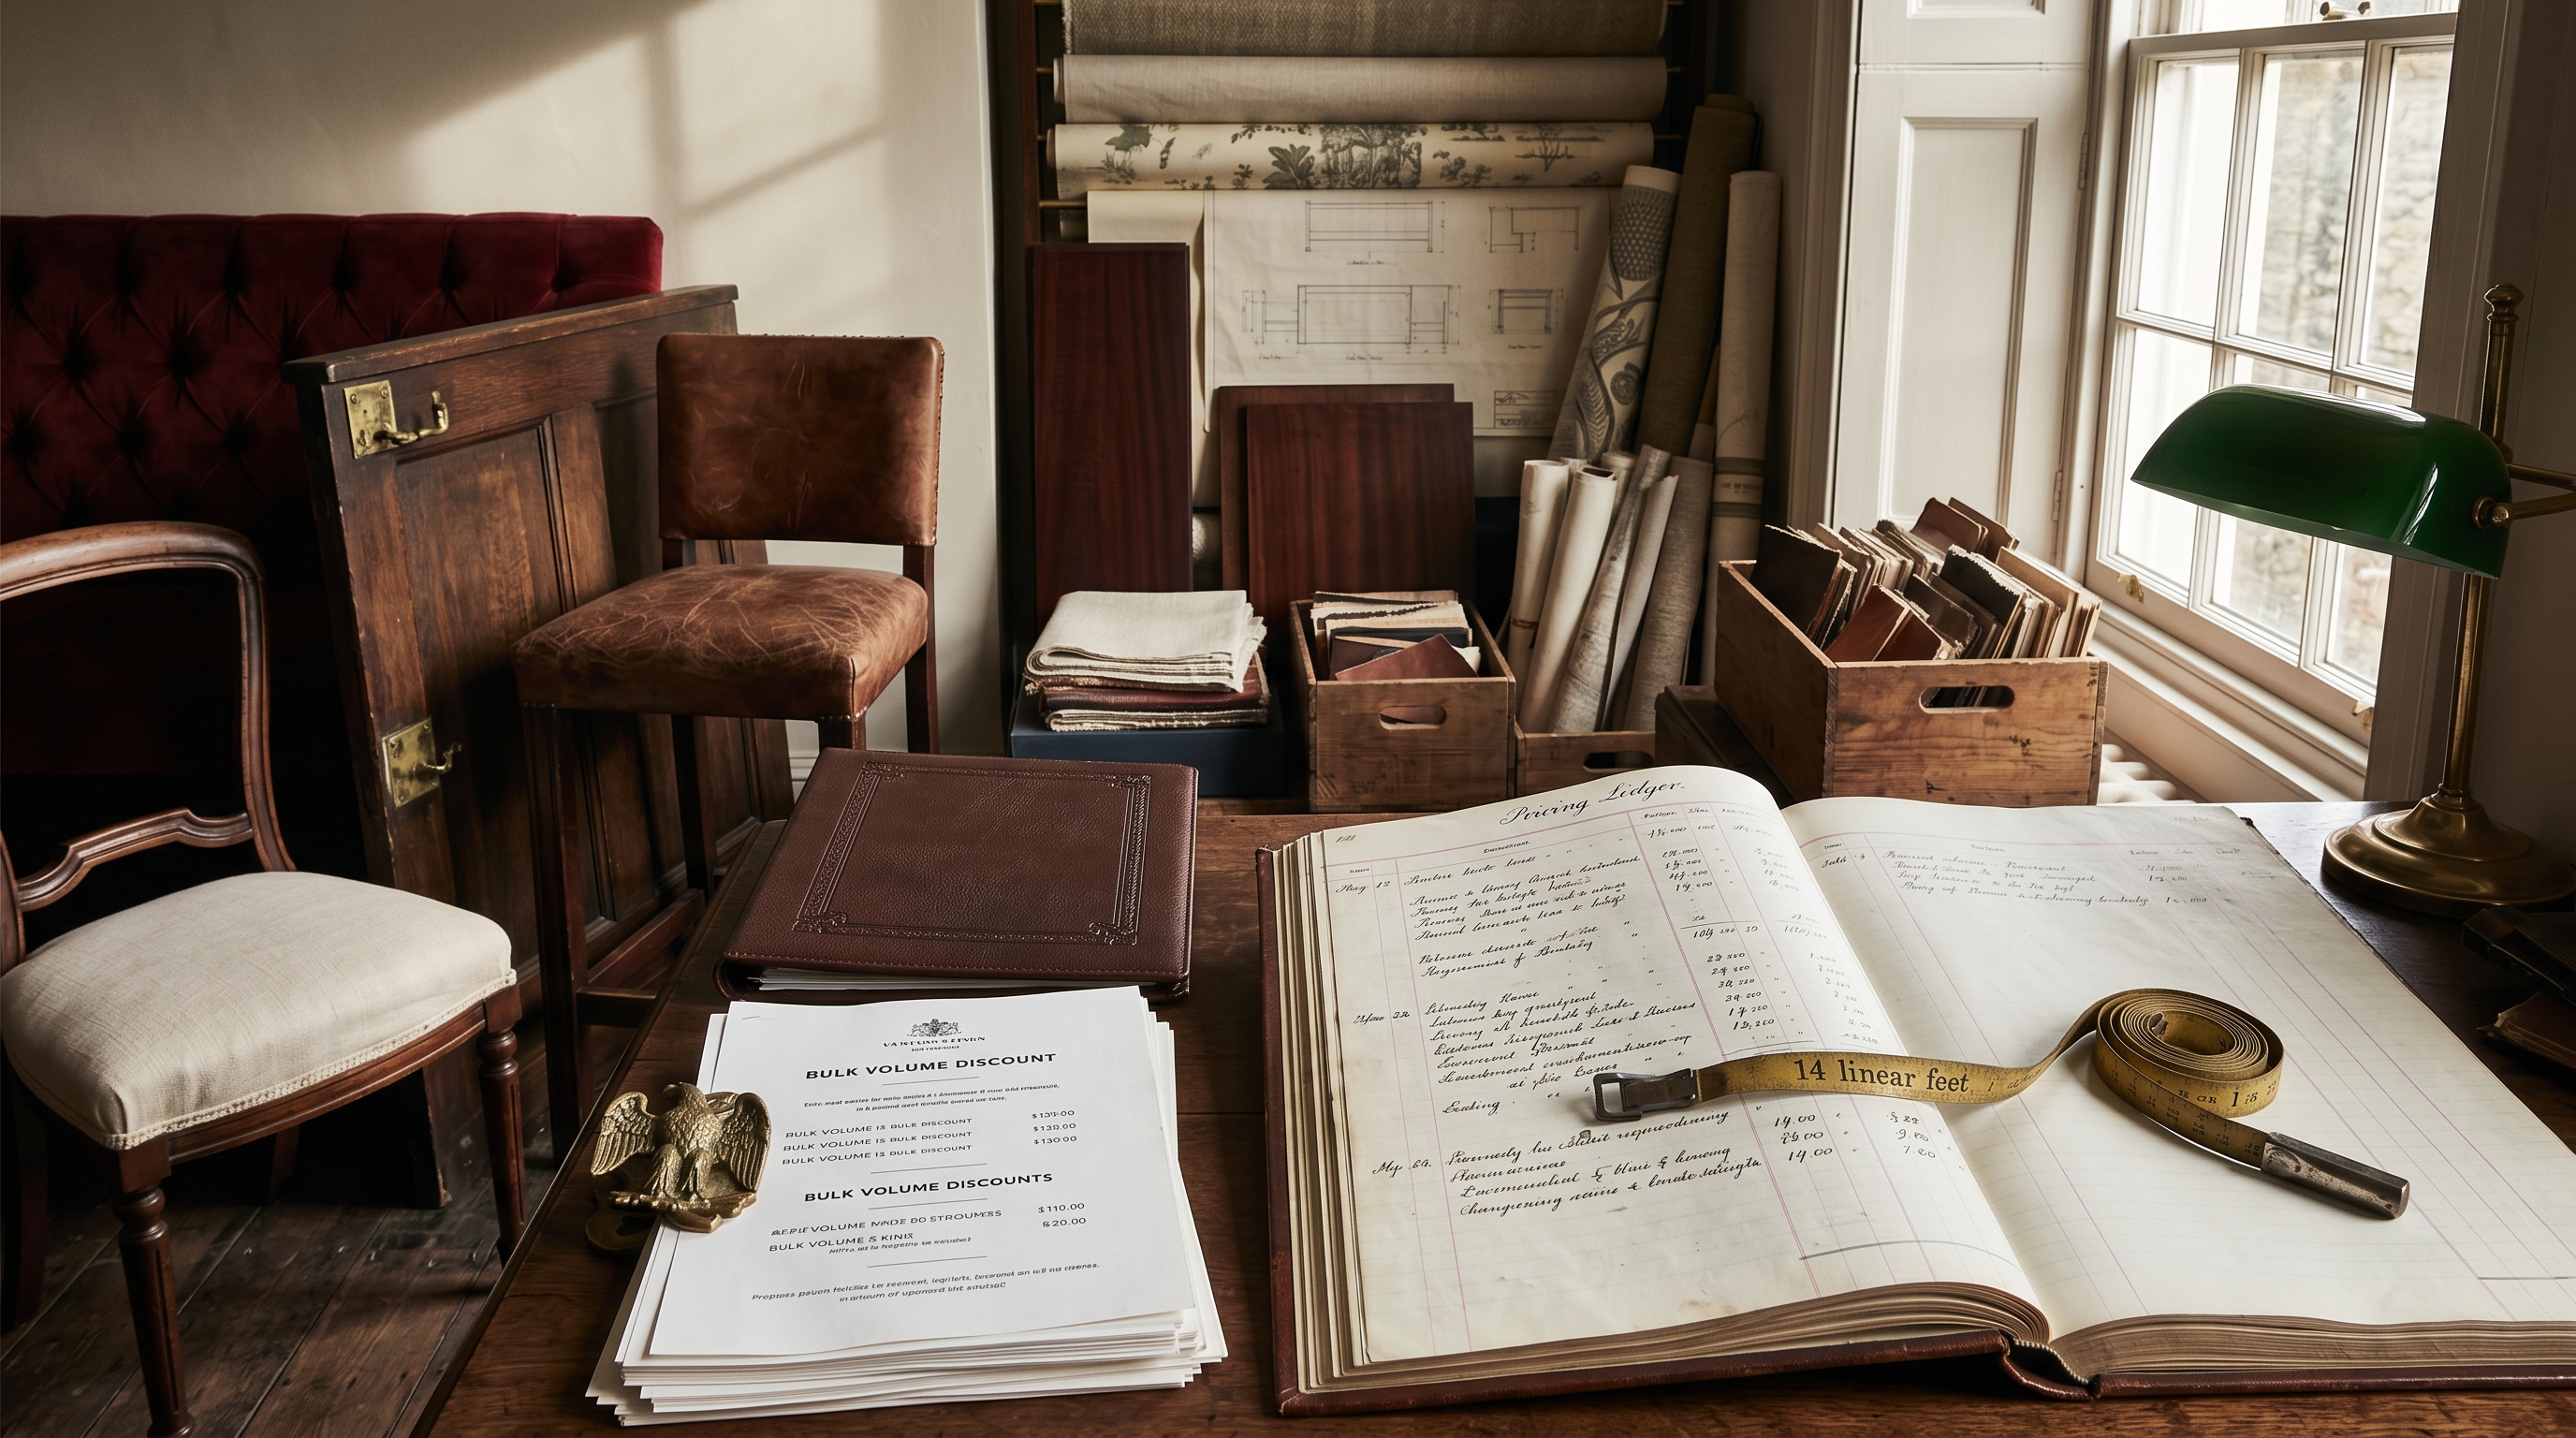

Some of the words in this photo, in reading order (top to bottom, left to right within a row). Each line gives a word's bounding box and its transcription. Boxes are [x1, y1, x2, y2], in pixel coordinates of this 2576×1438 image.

[806, 1068, 857, 1078] BULK
[866, 1062, 947, 1074] VOLUME
[957, 1054, 1056, 1068] DISCOUNT
[1793, 1059, 1826, 1080] 14
[1837, 1059, 1917, 1088] linear
[822, 1126, 872, 1135] VOLUME
[820, 1139, 871, 1148] VOLUME
[819, 1152, 871, 1162] VOLUME
[921, 1145, 972, 1153] DISCOUNT
[805, 1190, 853, 1201] BULK
[860, 1182, 939, 1196] VOLUME
[947, 1174, 1052, 1189] DISCOUNTS
[811, 1223, 865, 1232] VOLUME
[769, 1242, 803, 1252] BULK
[809, 1238, 864, 1247] VOLUME
